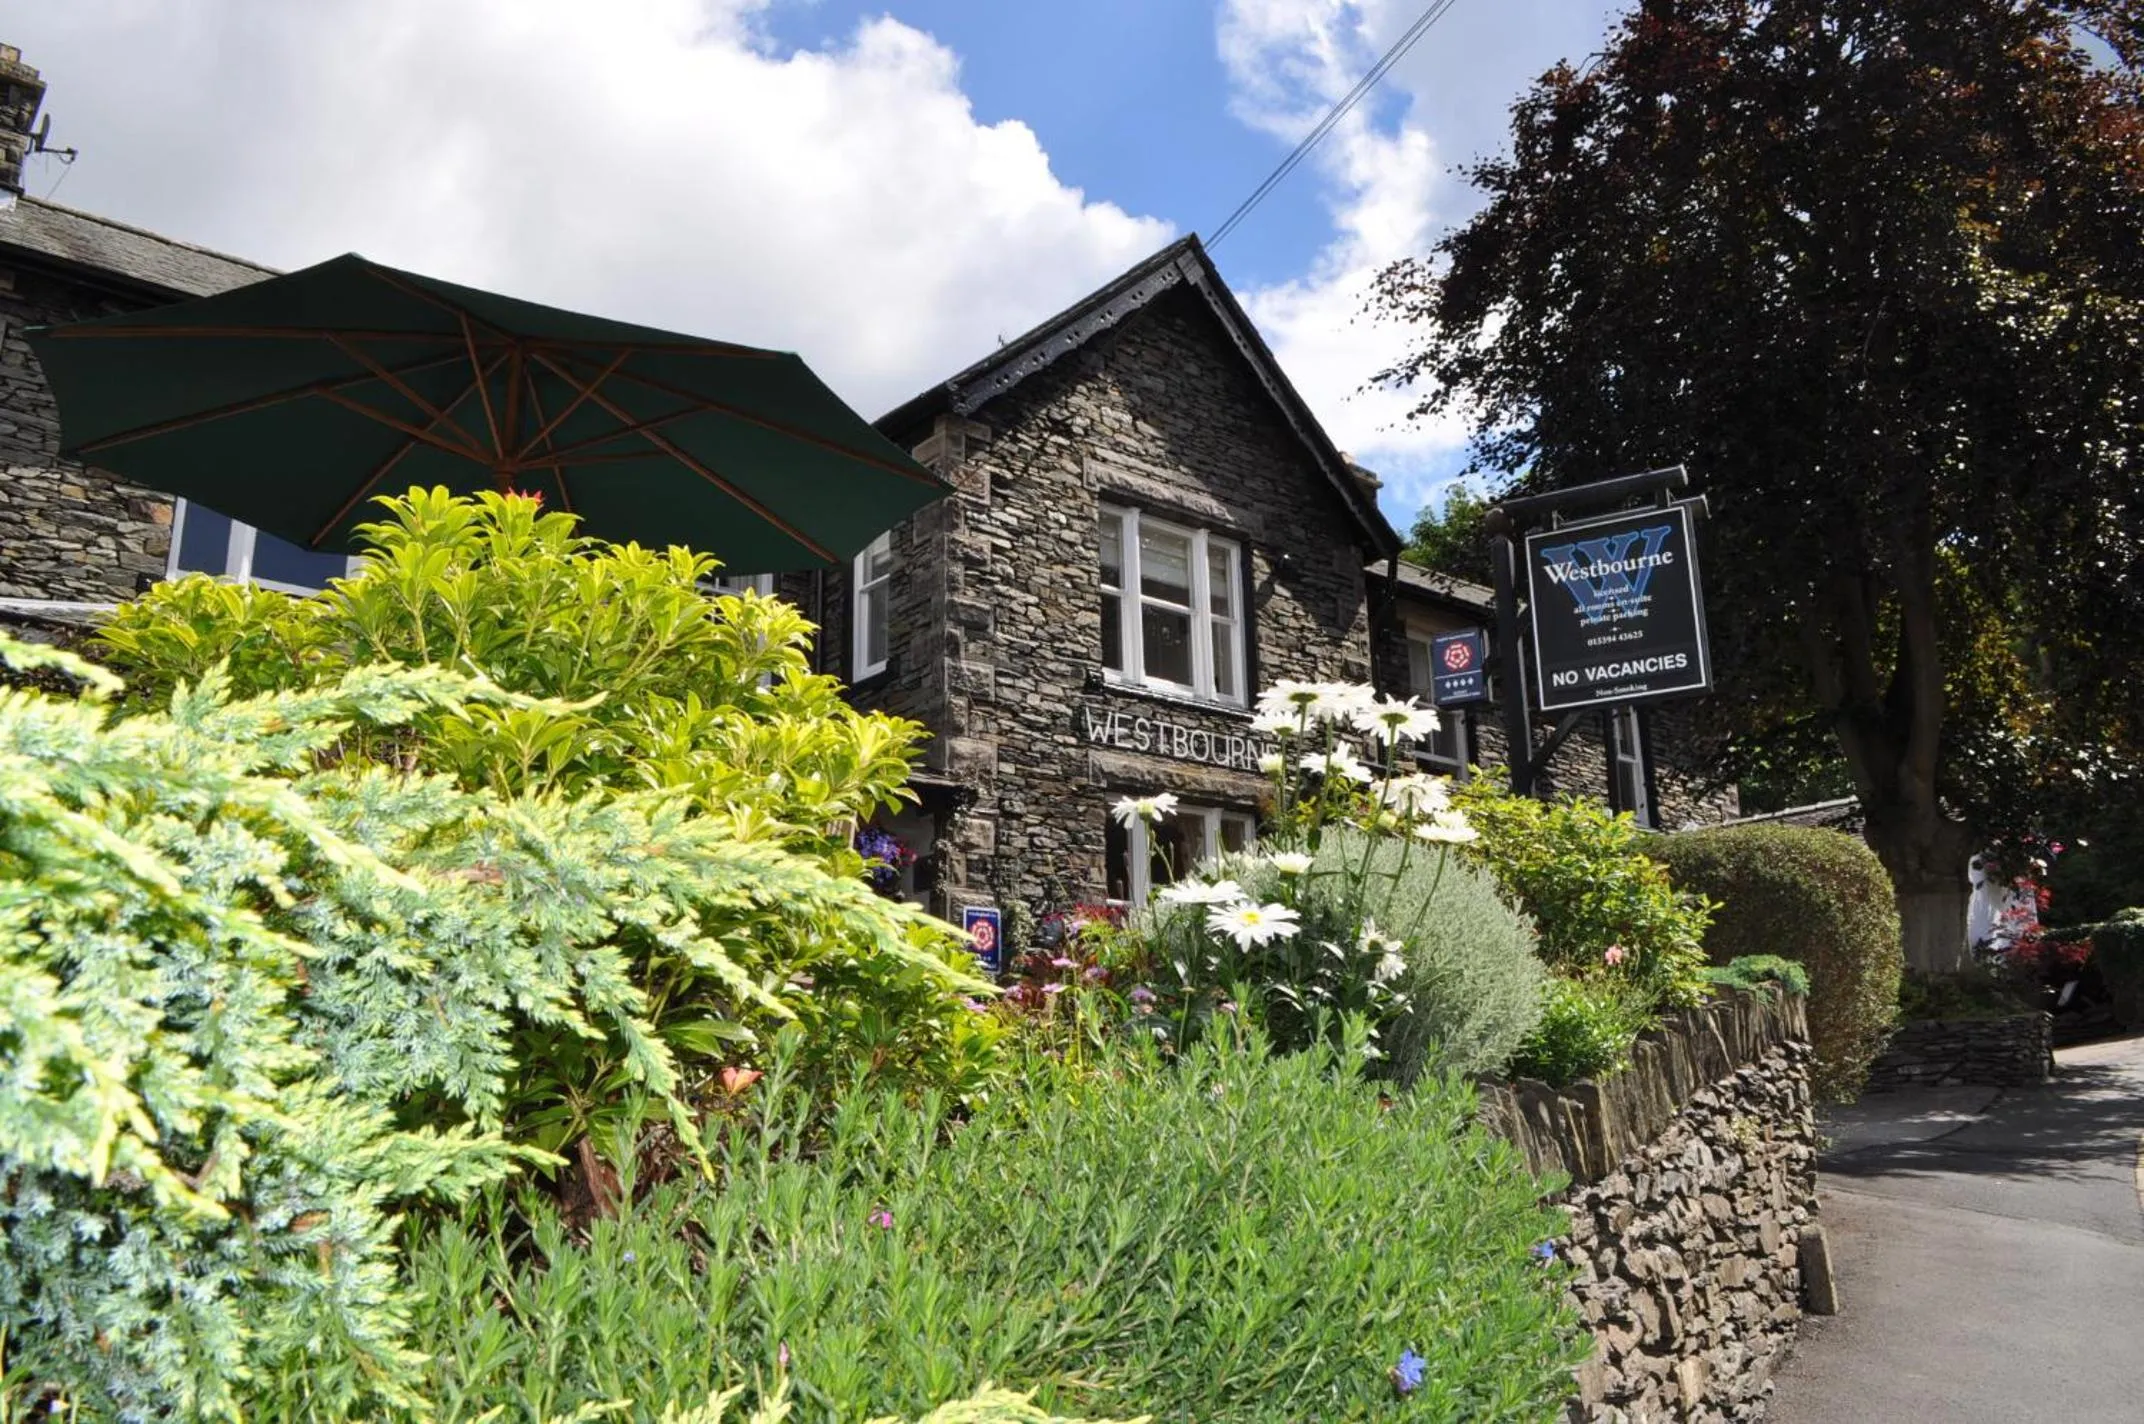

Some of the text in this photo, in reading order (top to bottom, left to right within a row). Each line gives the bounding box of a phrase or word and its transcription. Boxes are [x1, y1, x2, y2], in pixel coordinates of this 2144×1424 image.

[1543, 551, 1673, 584] Westbourne
[1580, 608, 1649, 628] private parking
[1552, 653, 1688, 687] NO VACANCIES
[1595, 684, 1648, 696] Non-Smoking
